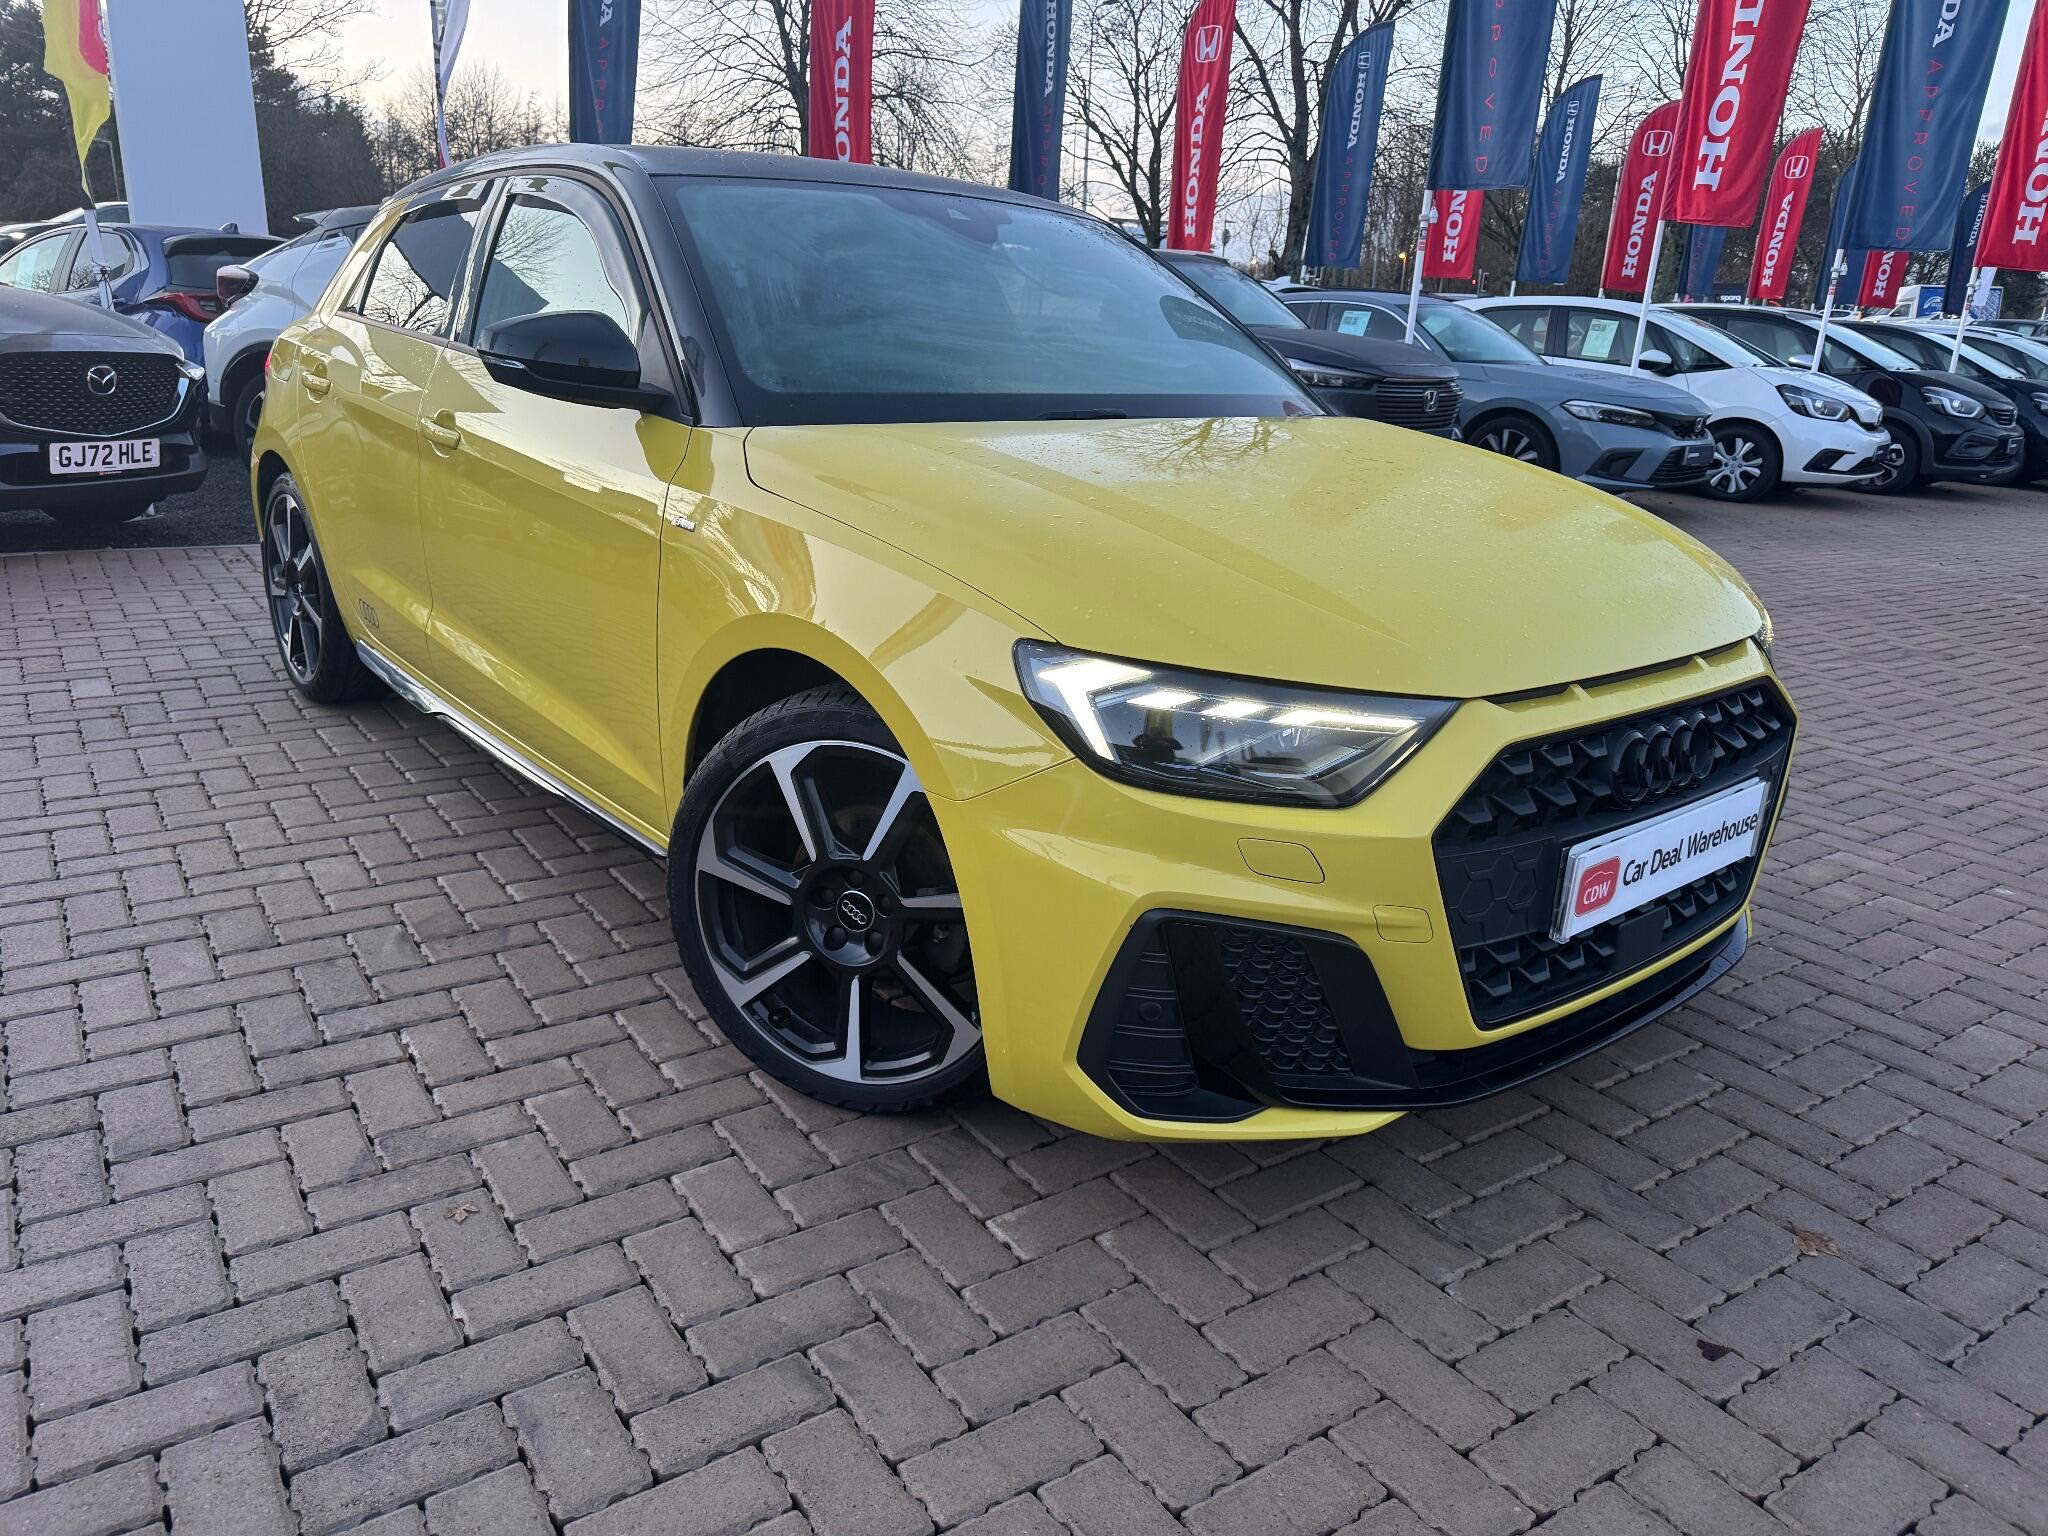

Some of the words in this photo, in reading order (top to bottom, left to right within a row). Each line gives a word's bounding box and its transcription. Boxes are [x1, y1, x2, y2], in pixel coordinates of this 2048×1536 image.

[1347, 71, 1367, 150] HONDA
[1896, 59, 1944, 241] APPROVED
[1184, 82, 1210, 238] HONDA
[1556, 117, 1576, 184] HONDA
[1327, 153, 1353, 262] APPROVED
[1621, 170, 1658, 278] HONDA
[1761, 191, 1795, 288] HONDA
[1966, 204, 1987, 248] HONDA
[58, 444, 113, 468] GJ72
[118, 441, 153, 465] HLE
[1623, 858, 1648, 888] Car
[1650, 838, 1682, 876] Deal
[1687, 811, 1758, 859] Warehouse
[1583, 879, 1611, 905] CDW
